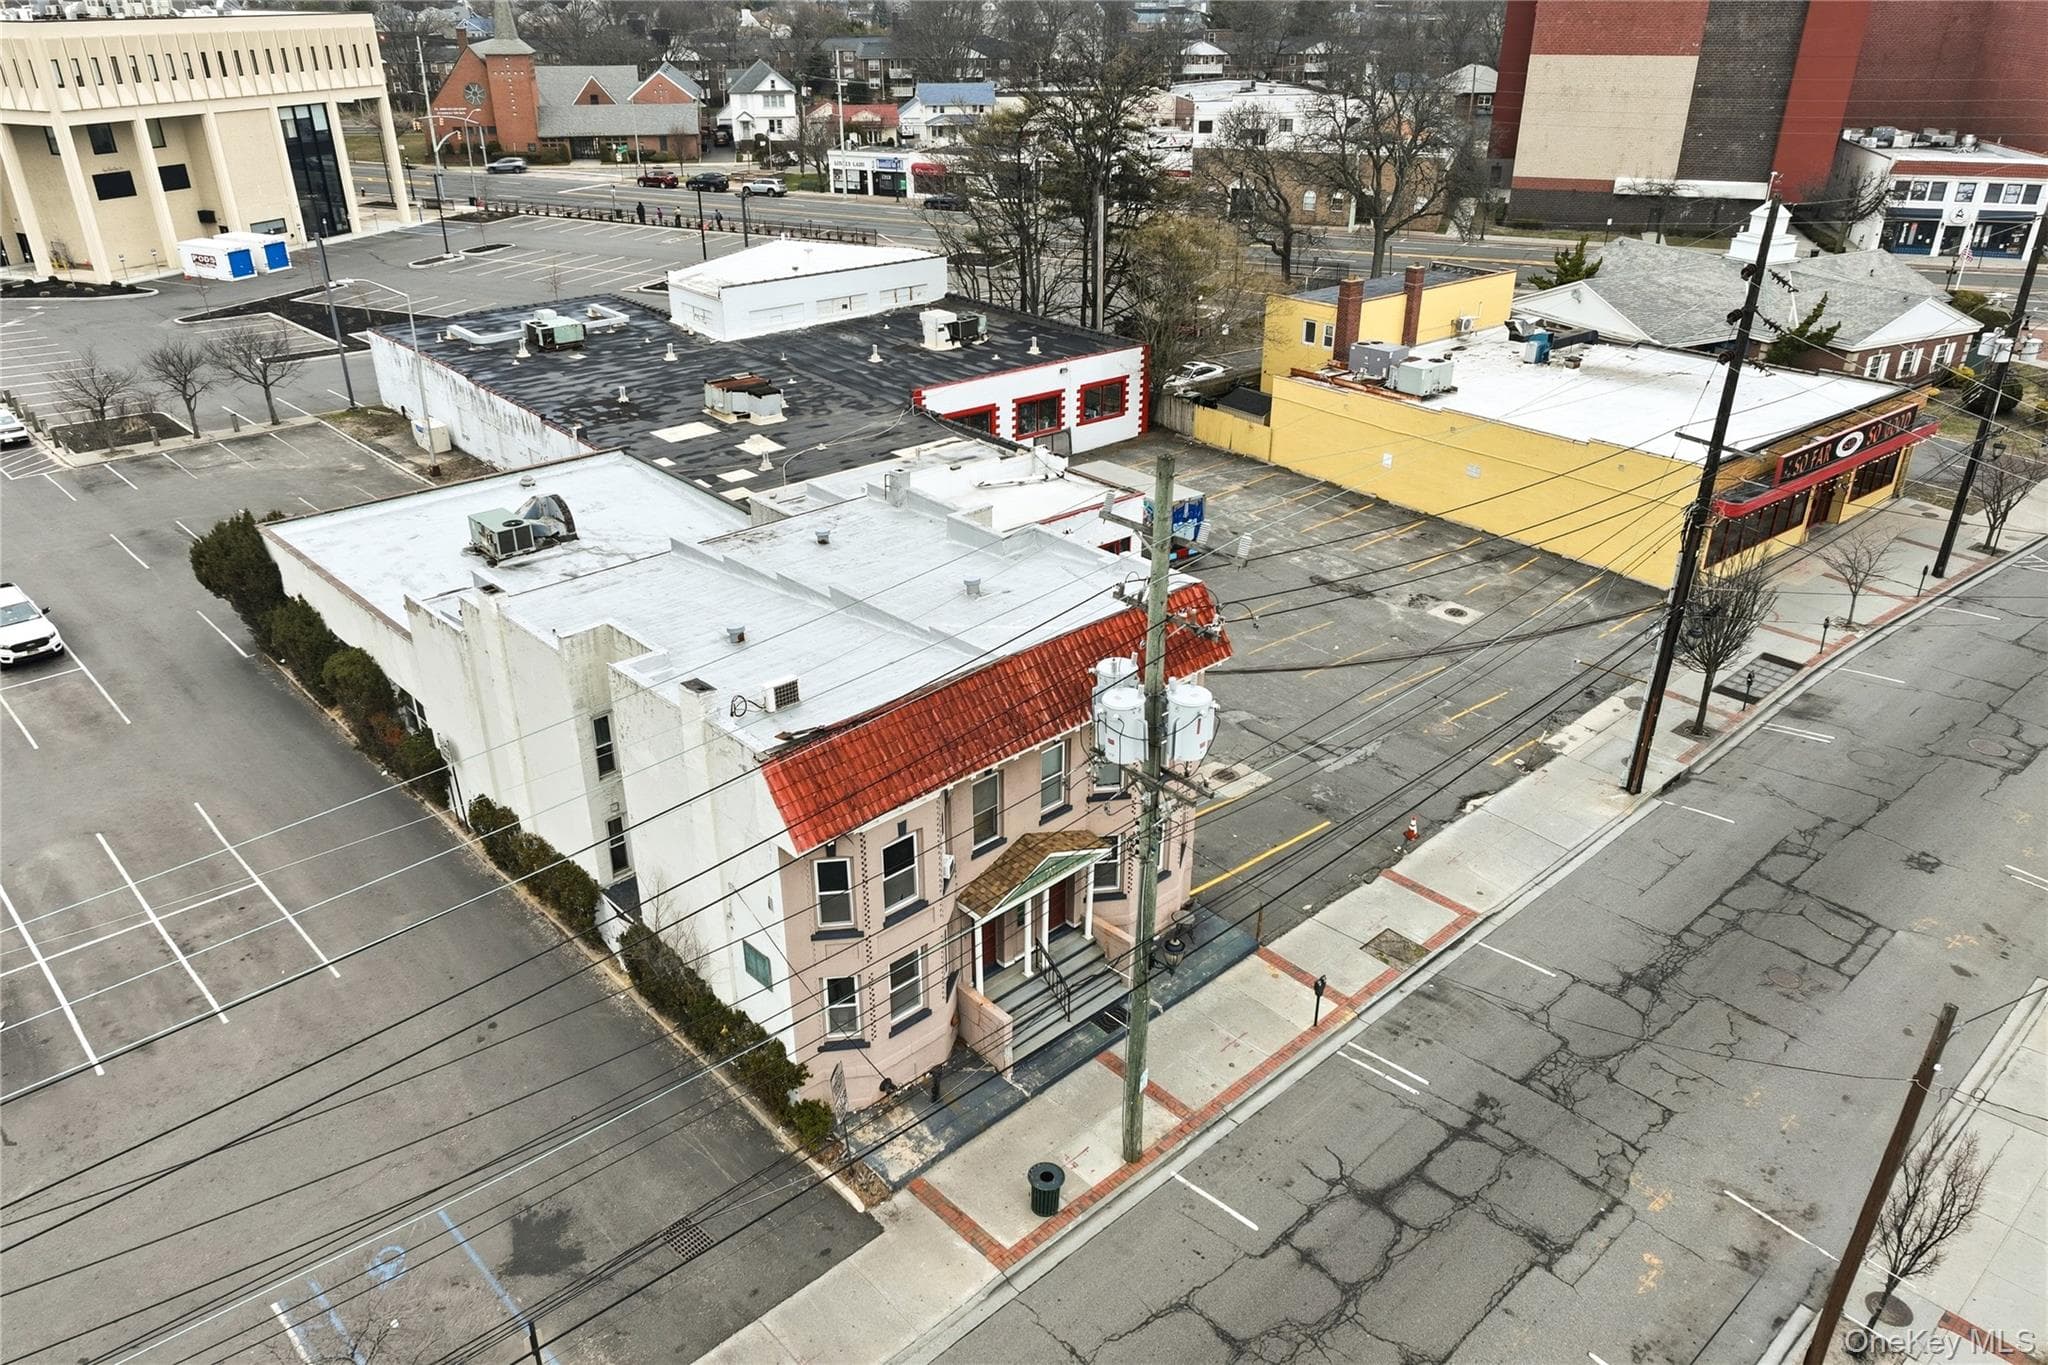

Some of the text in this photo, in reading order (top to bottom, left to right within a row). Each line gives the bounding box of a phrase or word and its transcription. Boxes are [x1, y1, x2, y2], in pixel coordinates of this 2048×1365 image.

[1794, 453, 1808, 472] SO
[1810, 443, 1832, 469] FAR
[1866, 423, 1882, 445] SO
